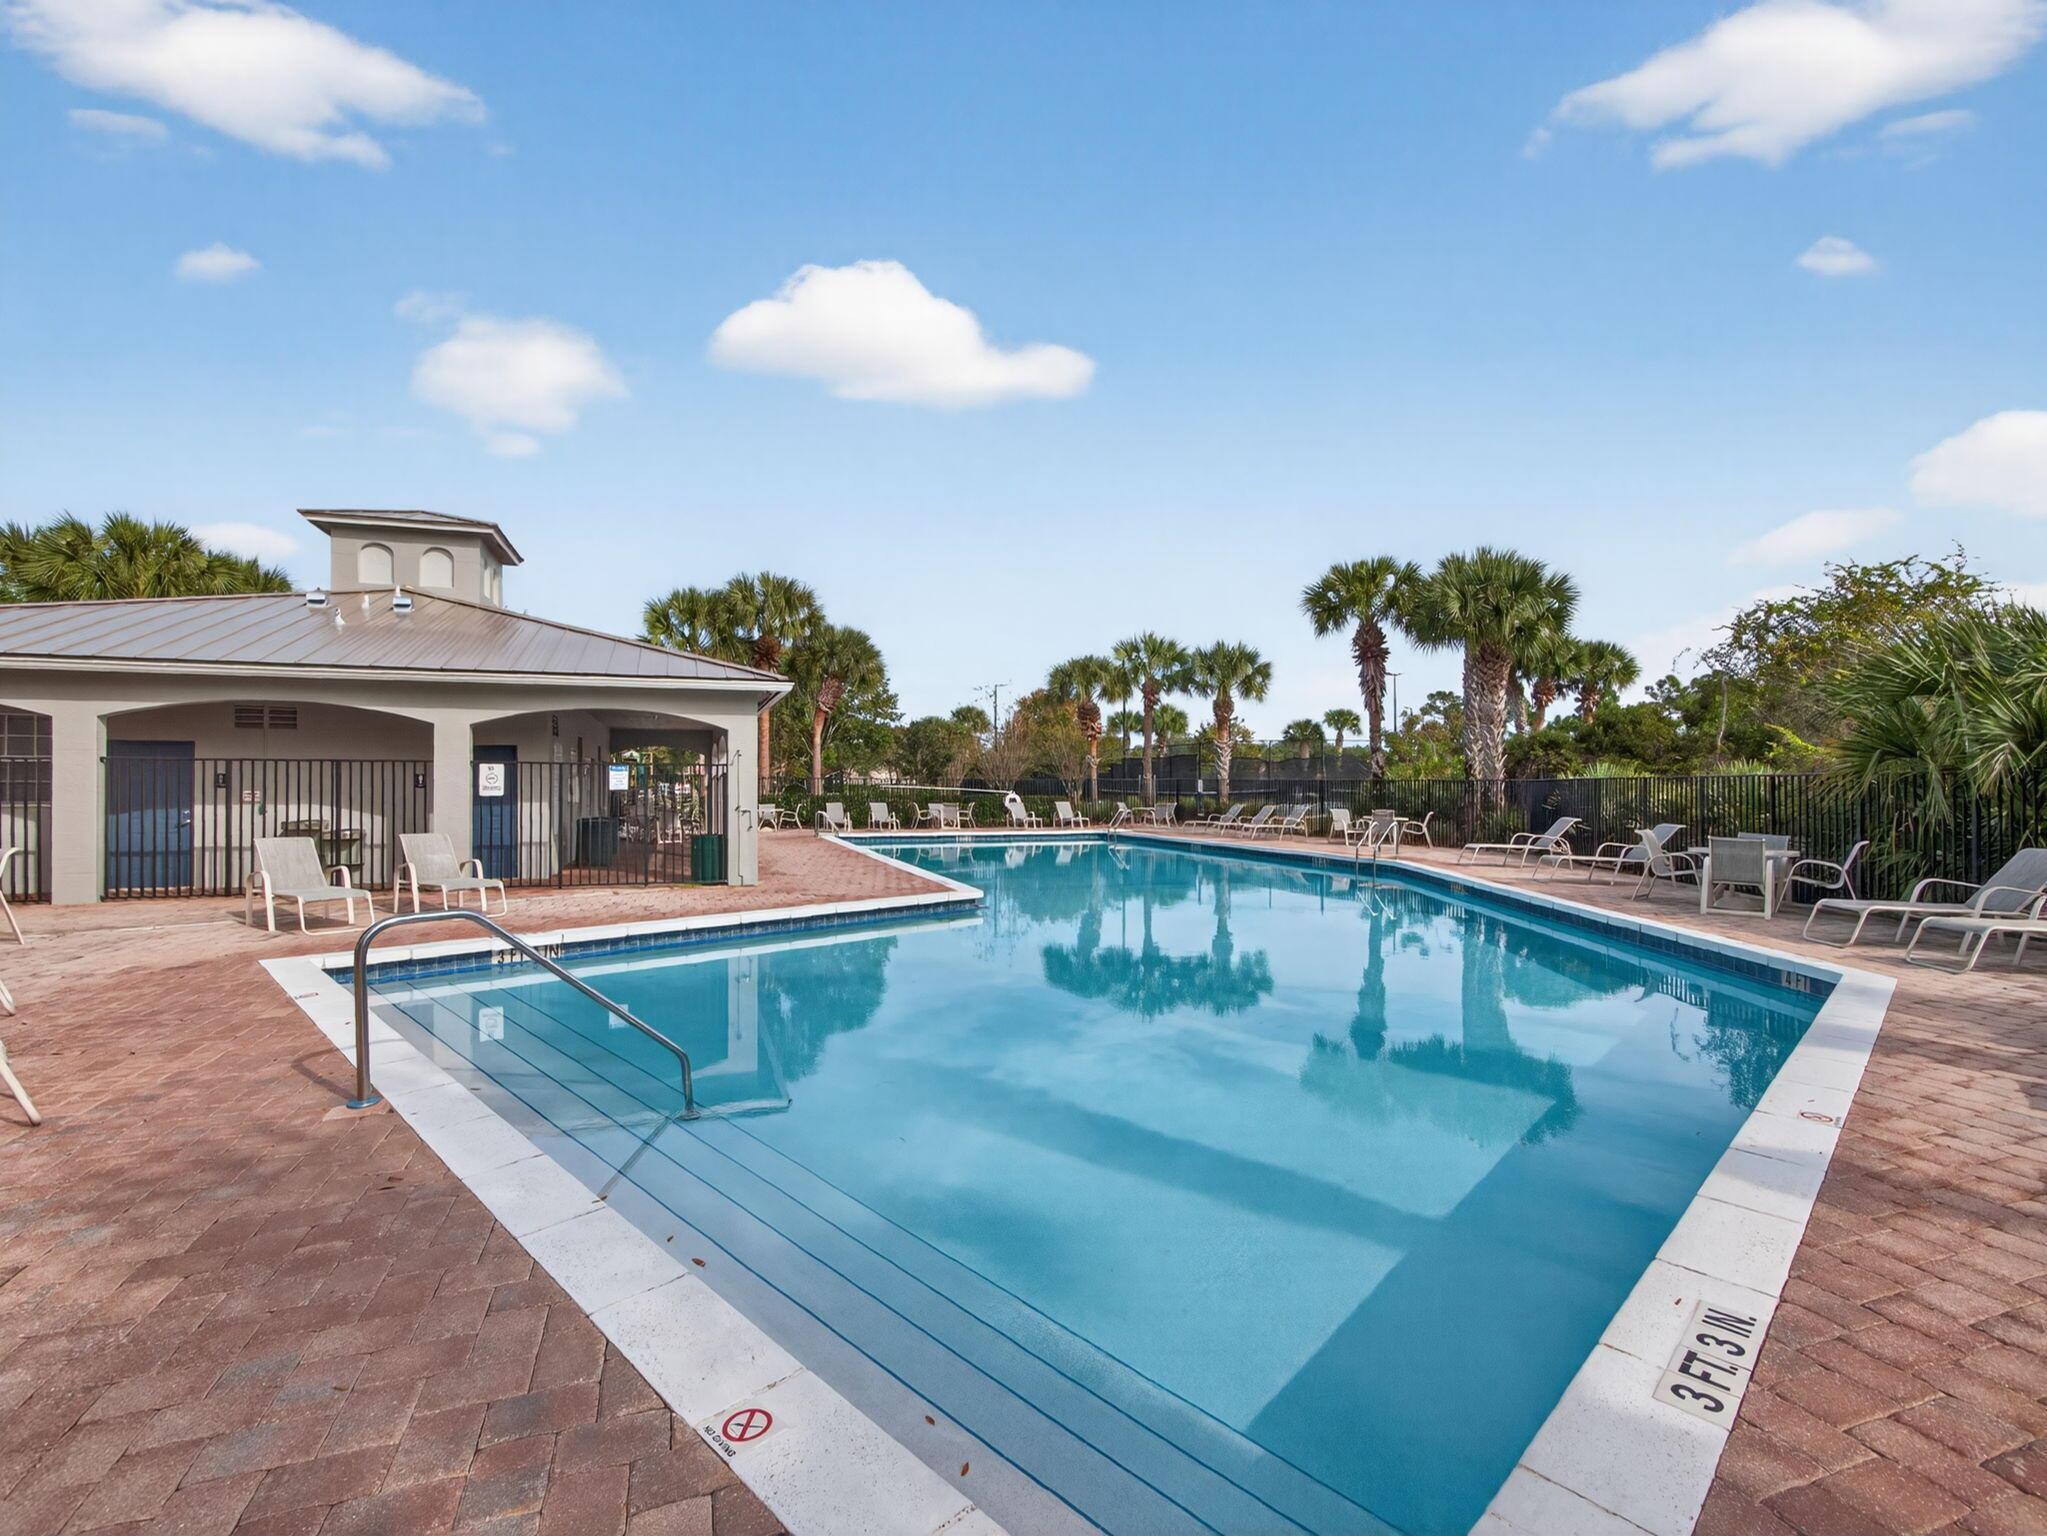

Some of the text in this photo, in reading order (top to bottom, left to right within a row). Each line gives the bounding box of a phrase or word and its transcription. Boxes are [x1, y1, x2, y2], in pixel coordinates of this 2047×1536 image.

[498, 950, 504, 963] 3
[1670, 1307, 1757, 1413] 3 FT. 3 IN.
